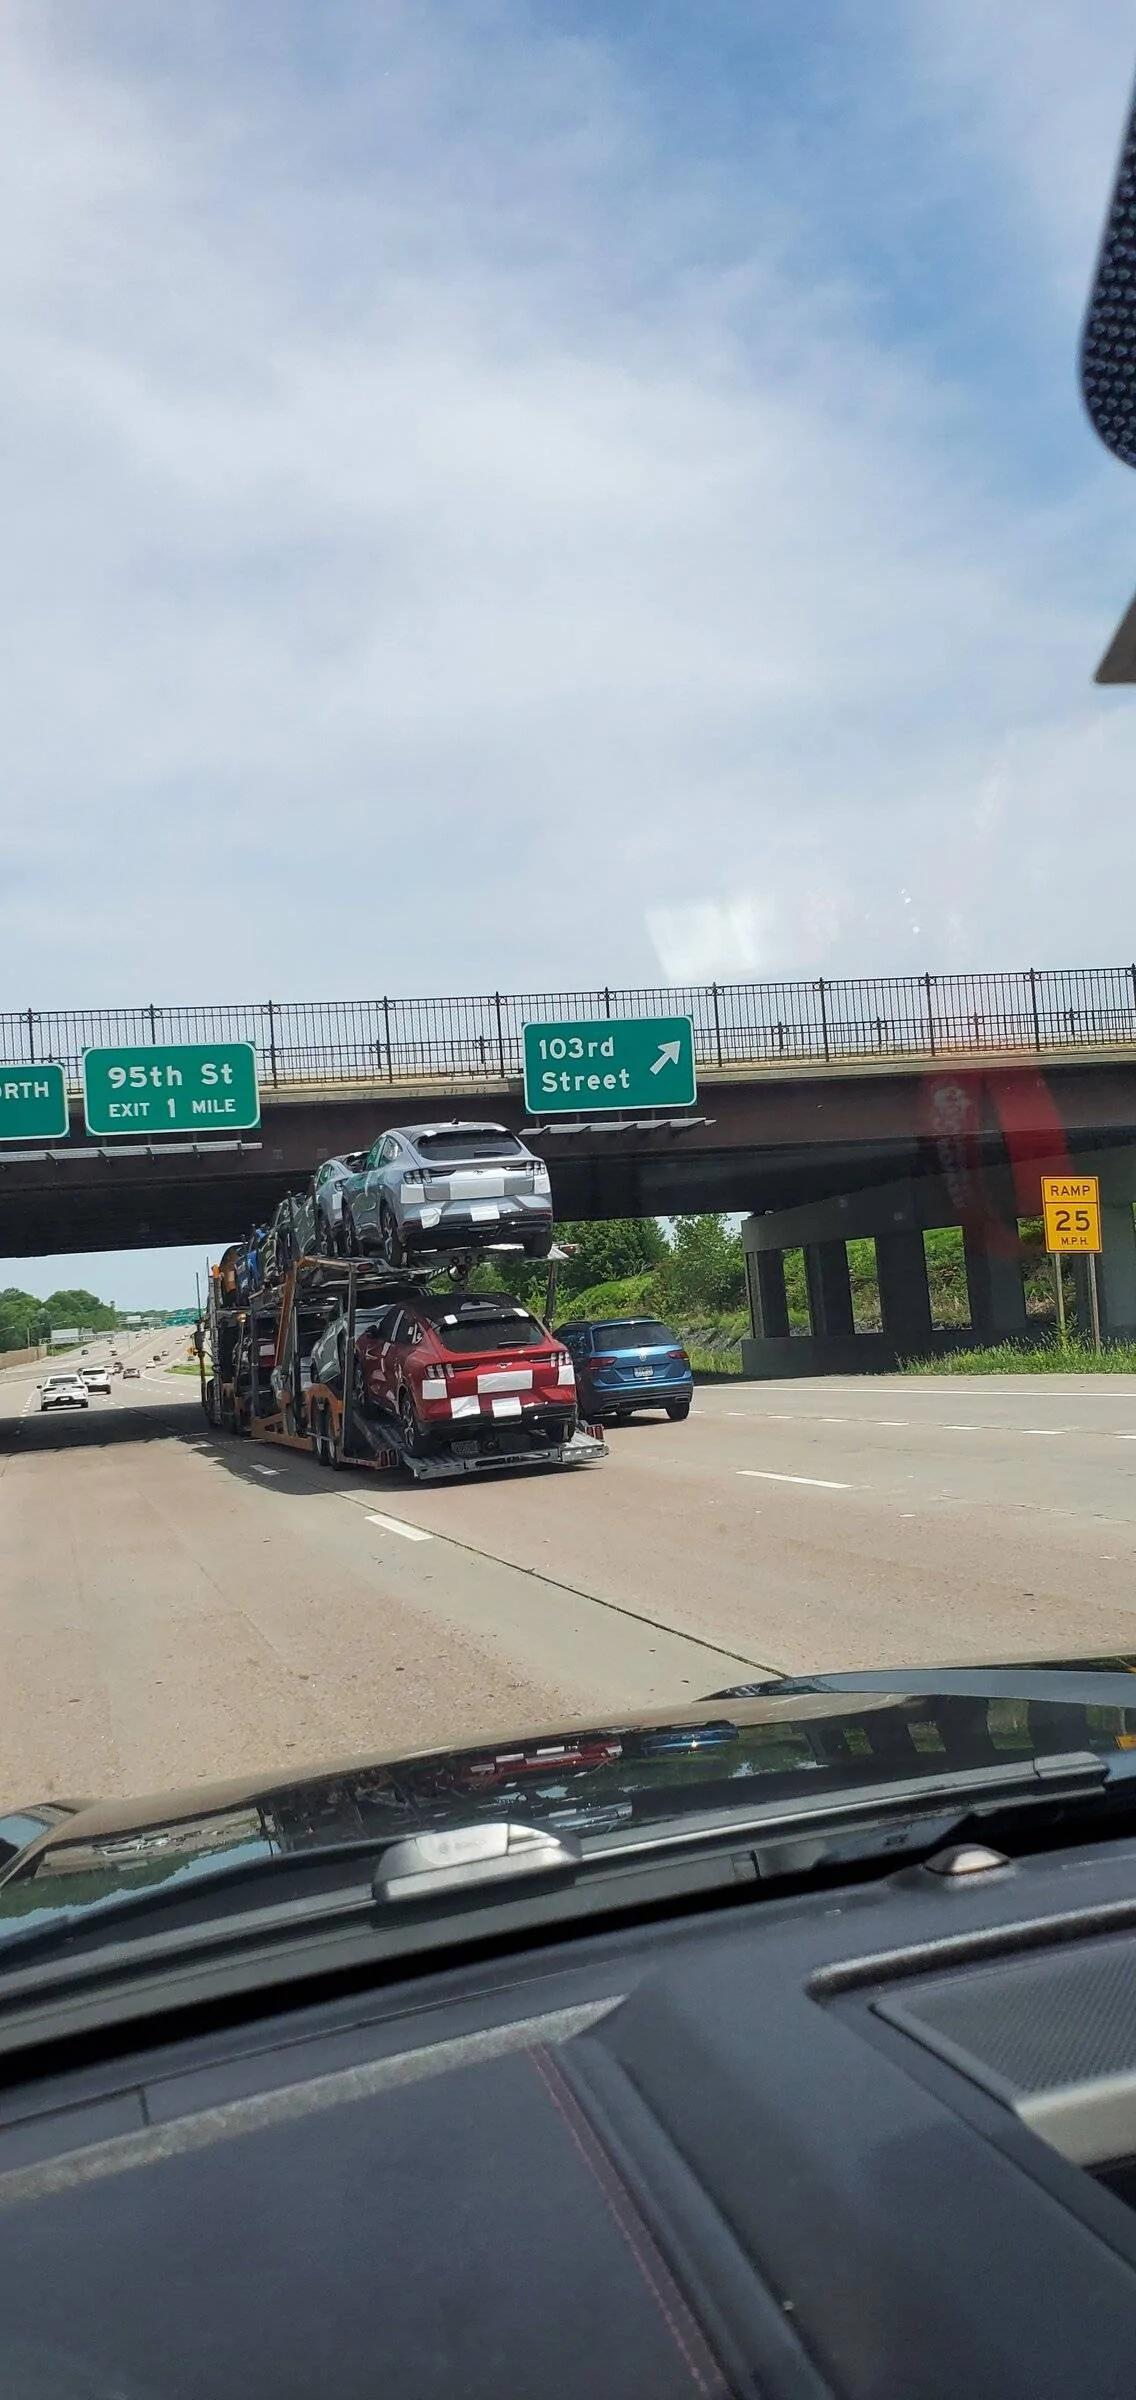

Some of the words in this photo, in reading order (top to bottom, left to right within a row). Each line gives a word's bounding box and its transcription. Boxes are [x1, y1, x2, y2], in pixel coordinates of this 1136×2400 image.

[539, 1036, 615, 1060] 103rd
[108, 1065, 183, 1089] 95th
[200, 1063, 233, 1085] St
[541, 1068, 630, 1093] Street
[0, 1081, 49, 1099] RTH
[108, 1102, 150, 1118] EXIT
[167, 1098, 177, 1118] 1
[192, 1098, 236, 1114] MILE
[1050, 1185, 1091, 1197] RAMP
[1055, 1210, 1091, 1232] 25
